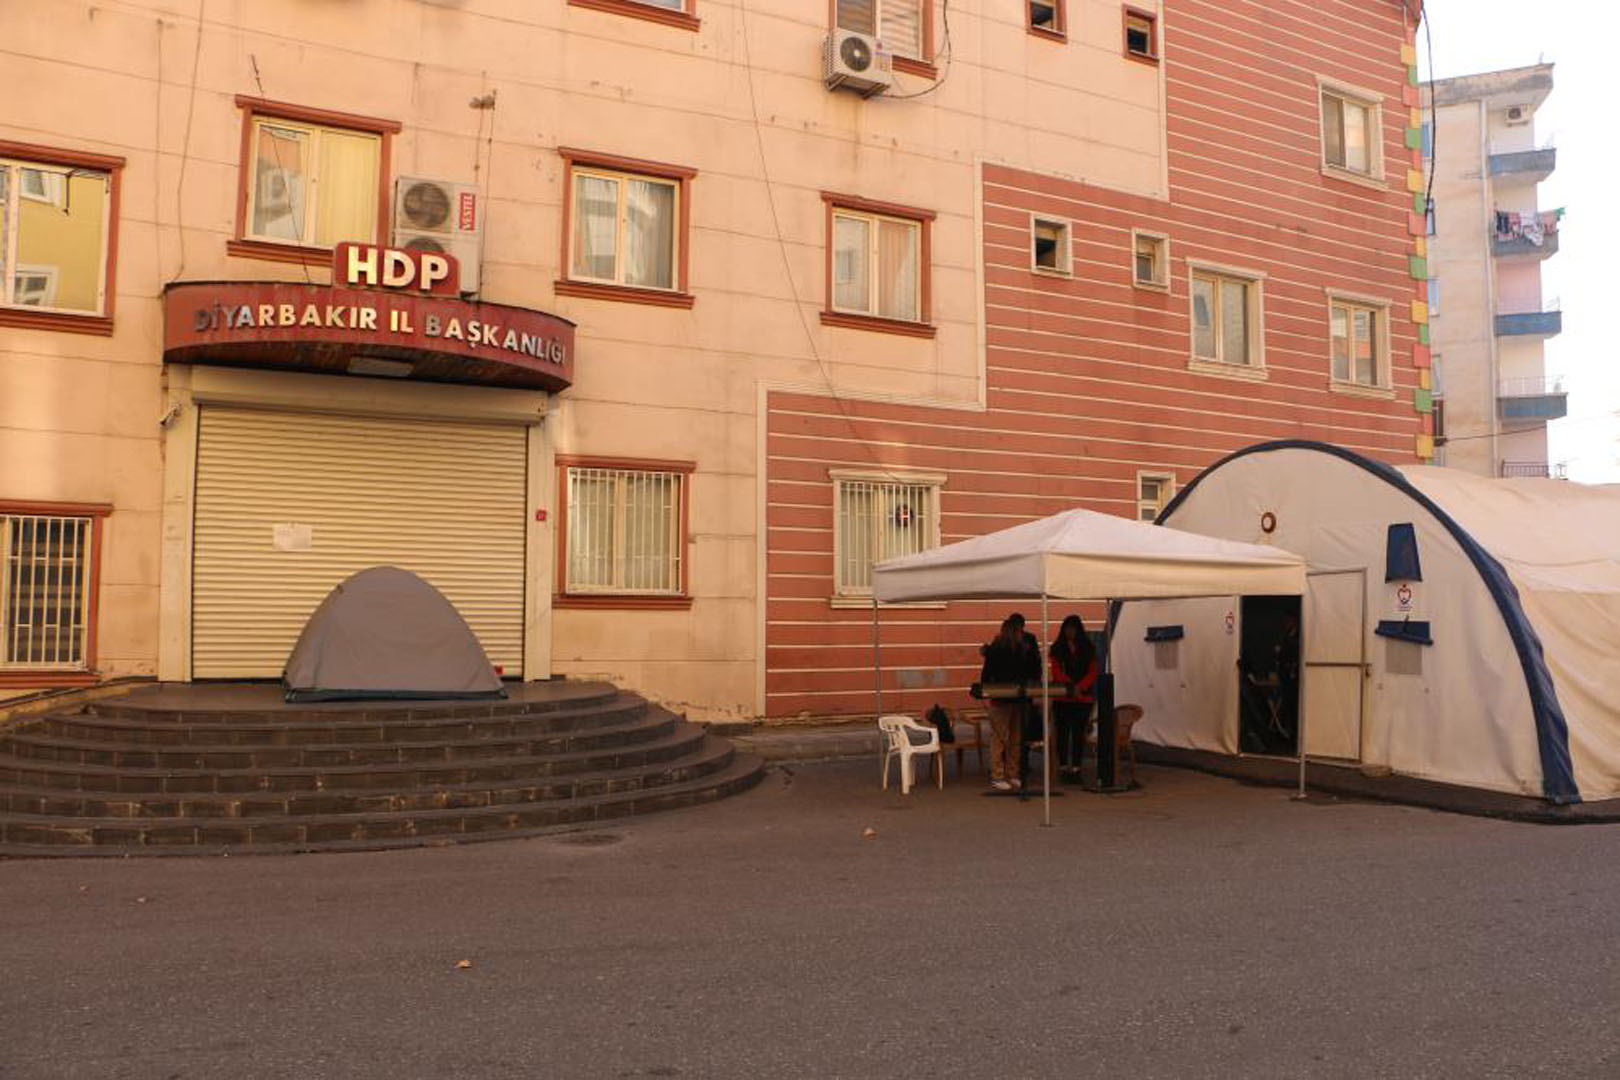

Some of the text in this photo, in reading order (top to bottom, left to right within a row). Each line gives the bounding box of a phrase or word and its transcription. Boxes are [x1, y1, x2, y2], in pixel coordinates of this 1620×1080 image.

[462, 194, 473, 231] VESTEL
[347, 246, 448, 290] HDP
[195, 303, 377, 331] DİYARBAKIR
[425, 313, 566, 365] BAŞKANLIĞI
